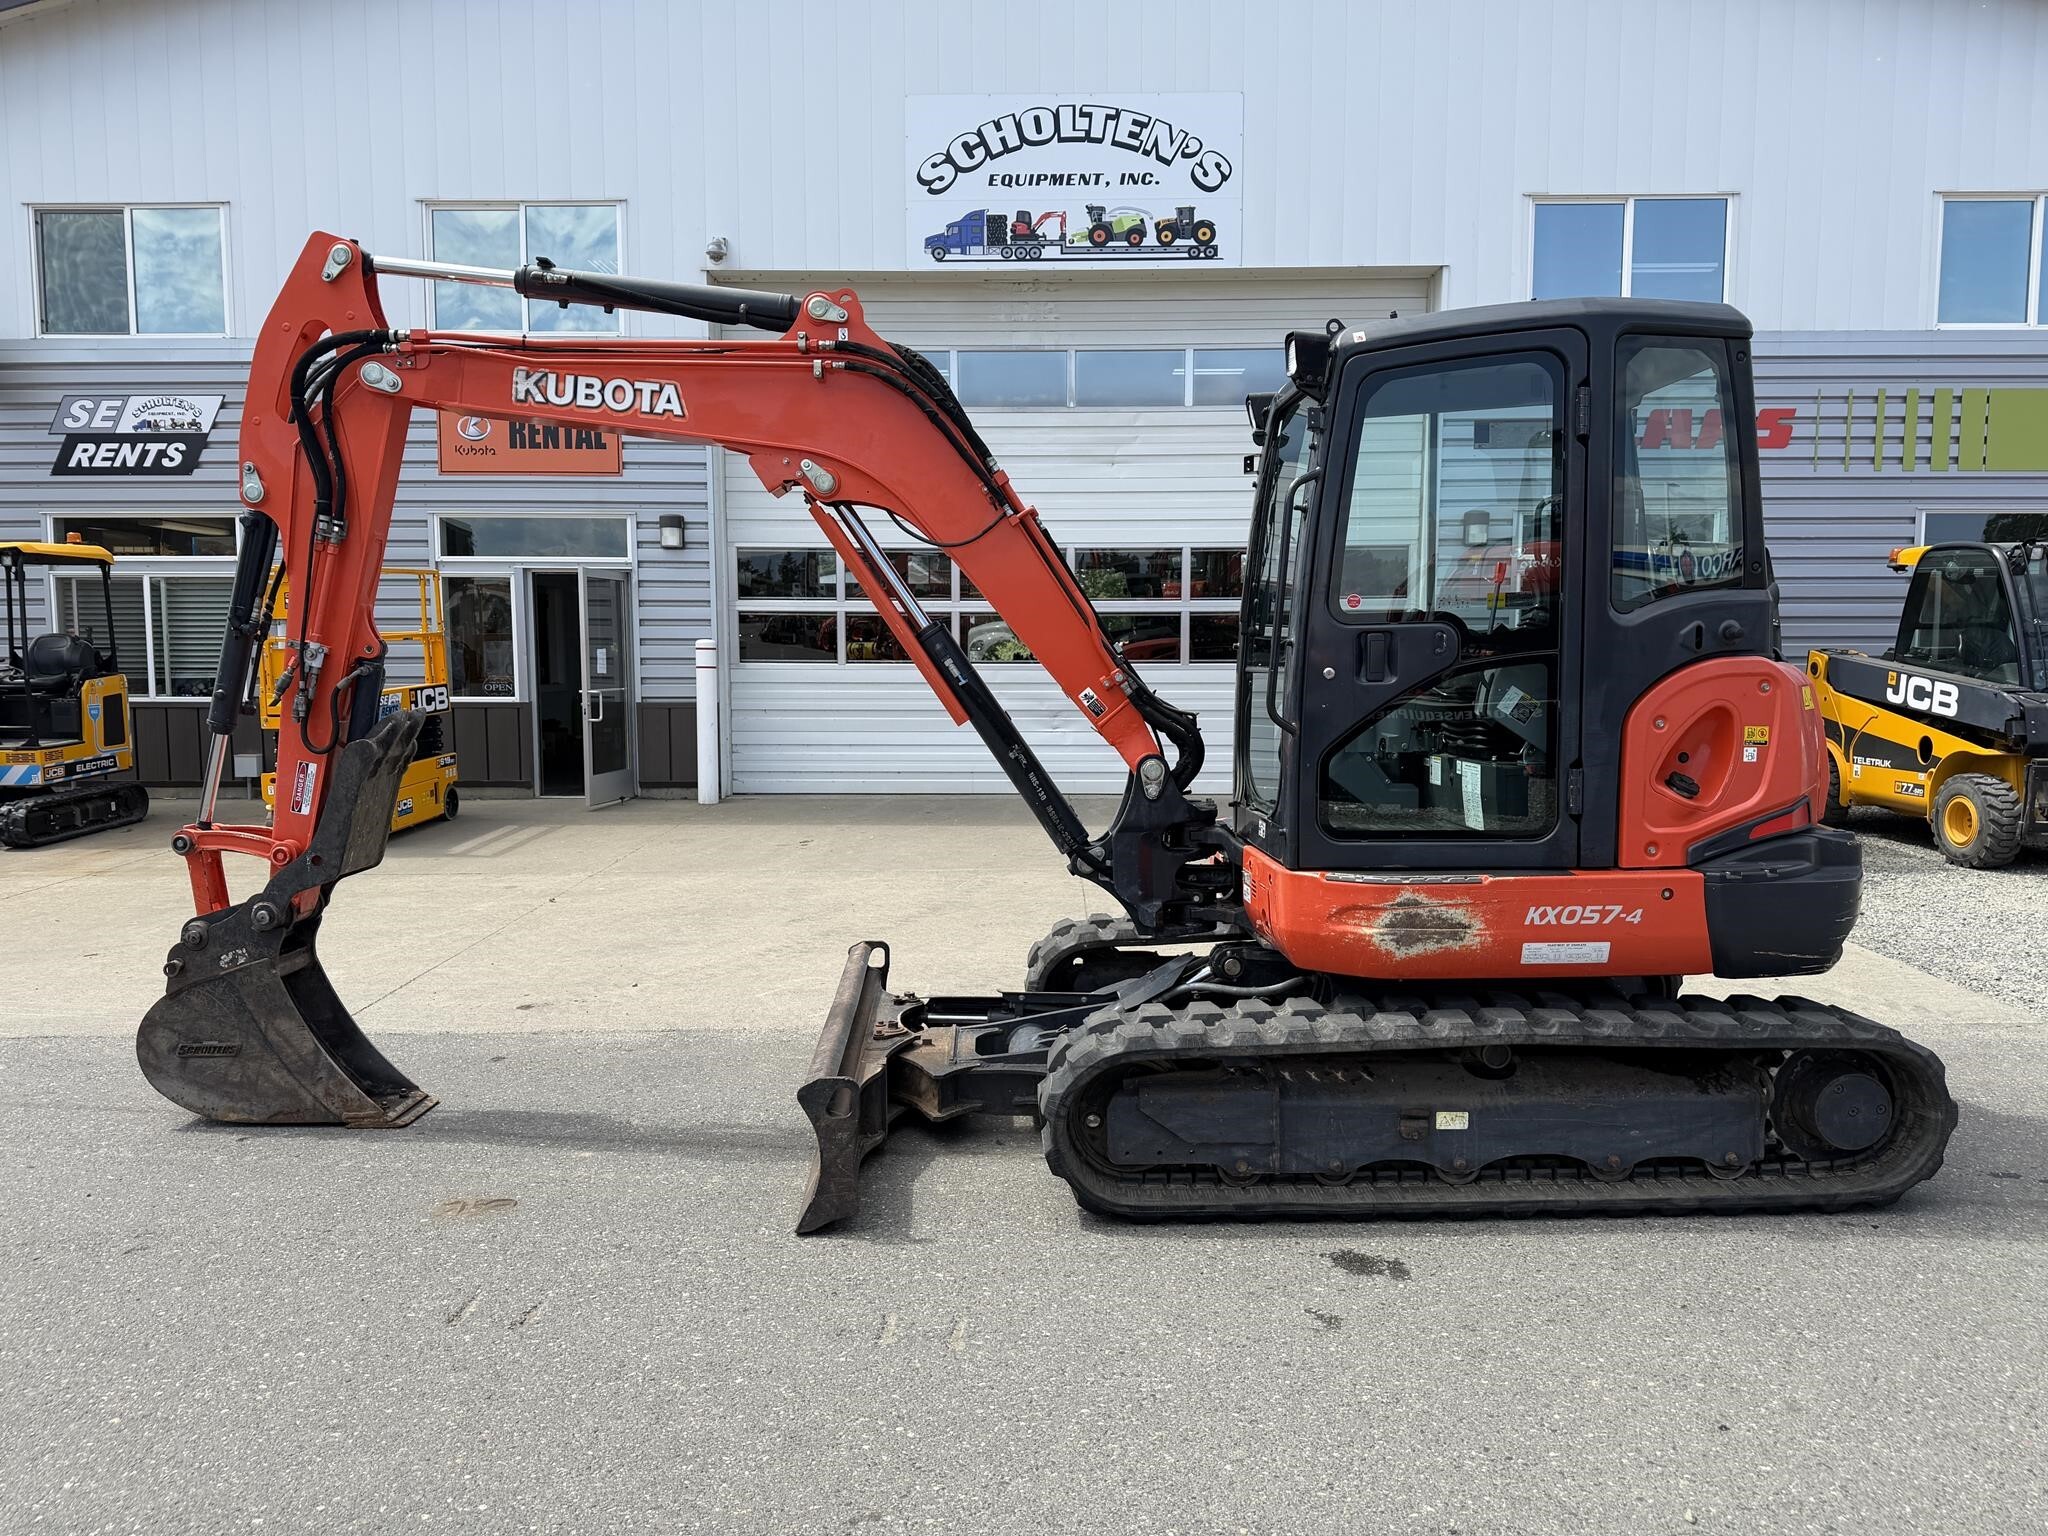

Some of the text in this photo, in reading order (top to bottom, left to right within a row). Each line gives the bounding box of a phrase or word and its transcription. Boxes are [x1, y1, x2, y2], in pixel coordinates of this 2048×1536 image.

[916, 104, 1233, 195] SCHOLTEN'S
[987, 172, 1161, 188] EQUIPMENT, INC.
[513, 368, 685, 418] KUBOTA
[63, 398, 125, 429] SE
[67, 442, 187, 468] RENTS
[454, 444, 497, 456] Kubota
[484, 683, 513, 691] OPEN
[1886, 673, 1960, 717] JCB
[411, 685, 449, 713] JCB
[45, 766, 65, 778] JCB
[76, 759, 115, 773] ELECTRIC
[1853, 755, 1892, 768] TELETRUK
[295, 772, 305, 802] DANGER
[1523, 905, 1644, 925] KX057-4
